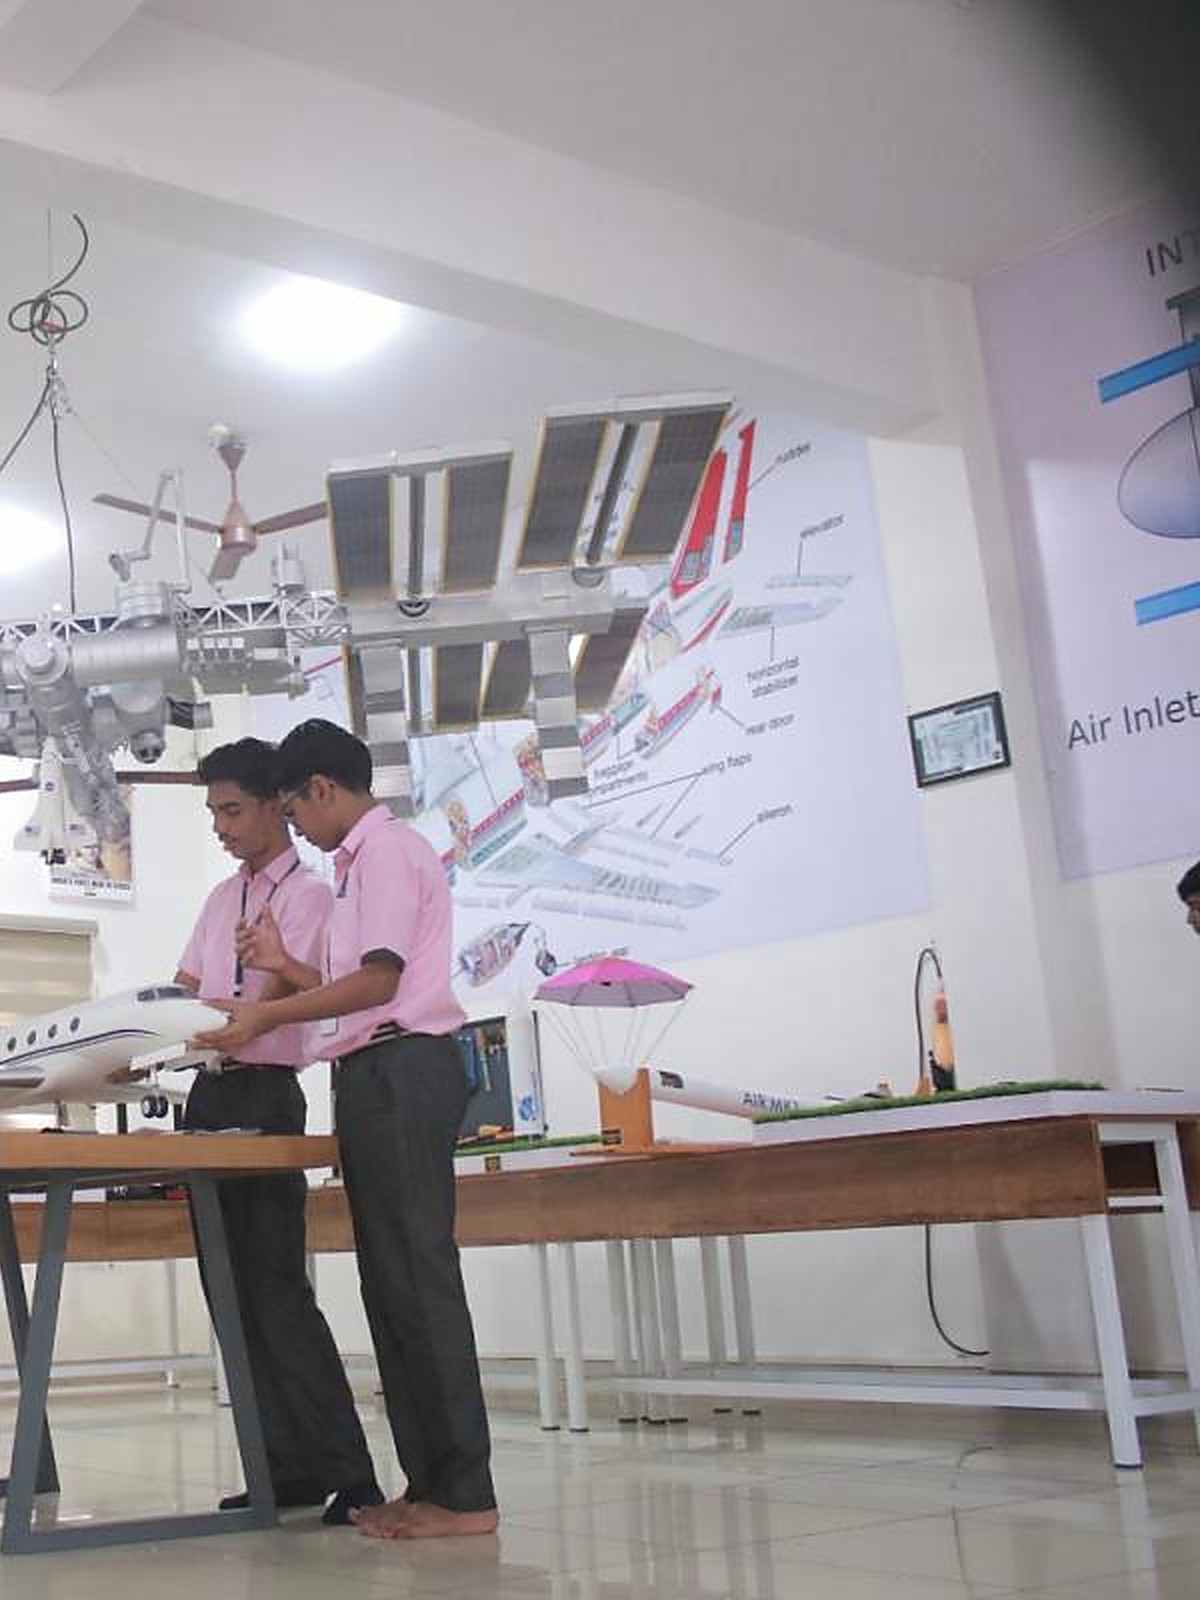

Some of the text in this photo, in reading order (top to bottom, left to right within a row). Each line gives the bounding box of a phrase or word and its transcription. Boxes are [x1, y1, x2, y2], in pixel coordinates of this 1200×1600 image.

[747, 656, 800, 684] horizontal
[1068, 690, 1200, 750] Air Inlet
